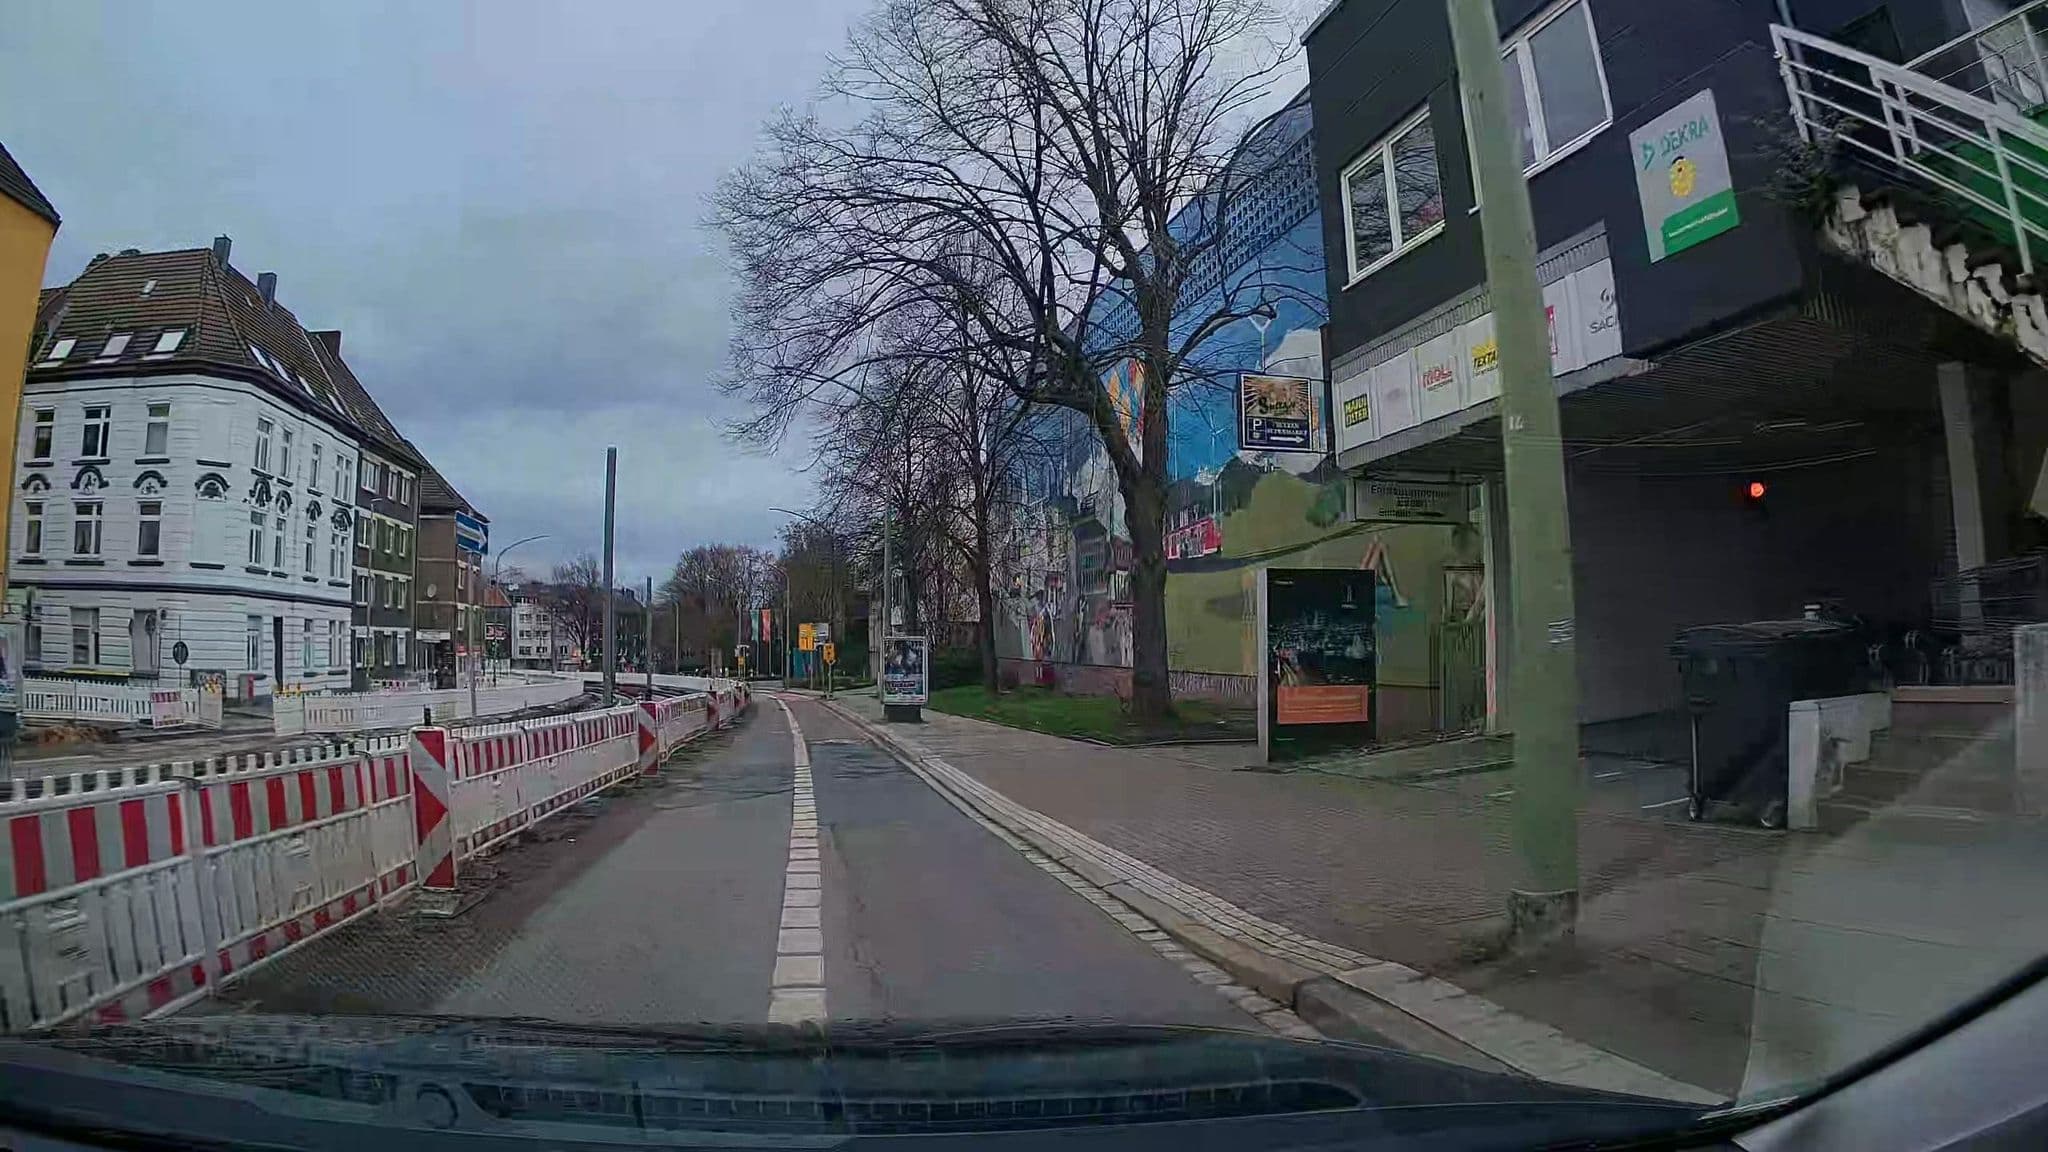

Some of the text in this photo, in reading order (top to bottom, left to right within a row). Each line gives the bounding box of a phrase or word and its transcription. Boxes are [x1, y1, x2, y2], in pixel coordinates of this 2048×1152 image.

[1660, 115, 1710, 157] DEKRA
[1590, 314, 1617, 334] SAC
[1253, 418, 1263, 431] P
